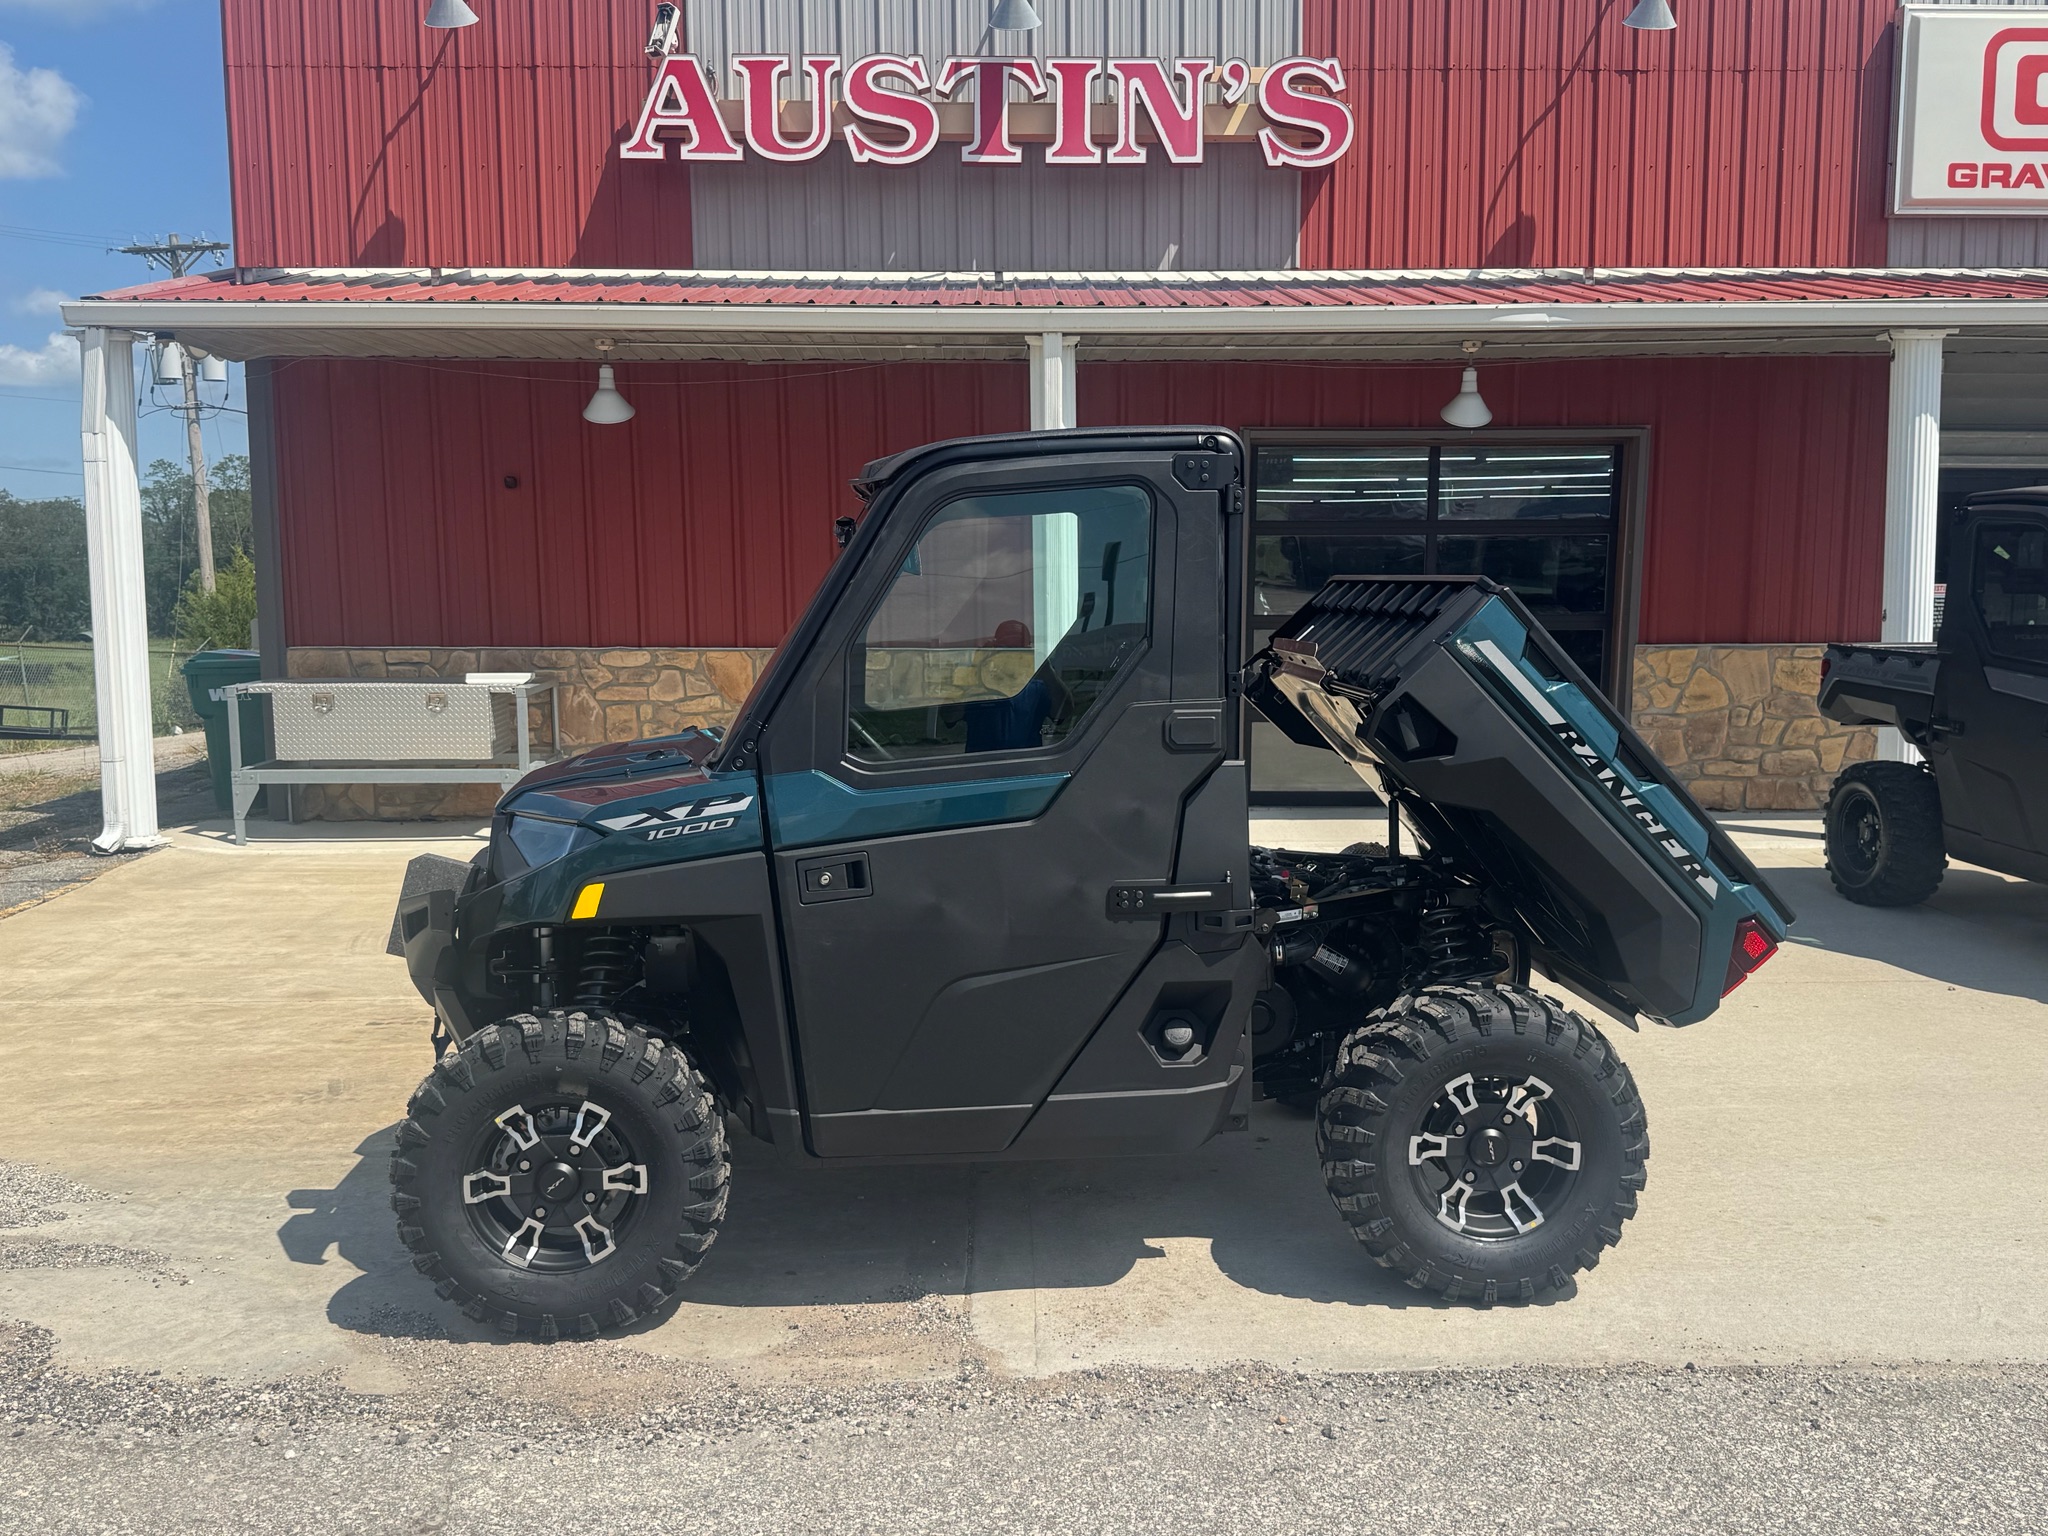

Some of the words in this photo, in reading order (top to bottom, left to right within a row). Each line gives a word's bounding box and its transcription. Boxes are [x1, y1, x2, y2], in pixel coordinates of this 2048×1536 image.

[1947, 162, 2048, 189] GRA
[622, 791, 748, 829] XP
[1549, 720, 1711, 884] RANGER
[647, 817, 735, 841] 1000
